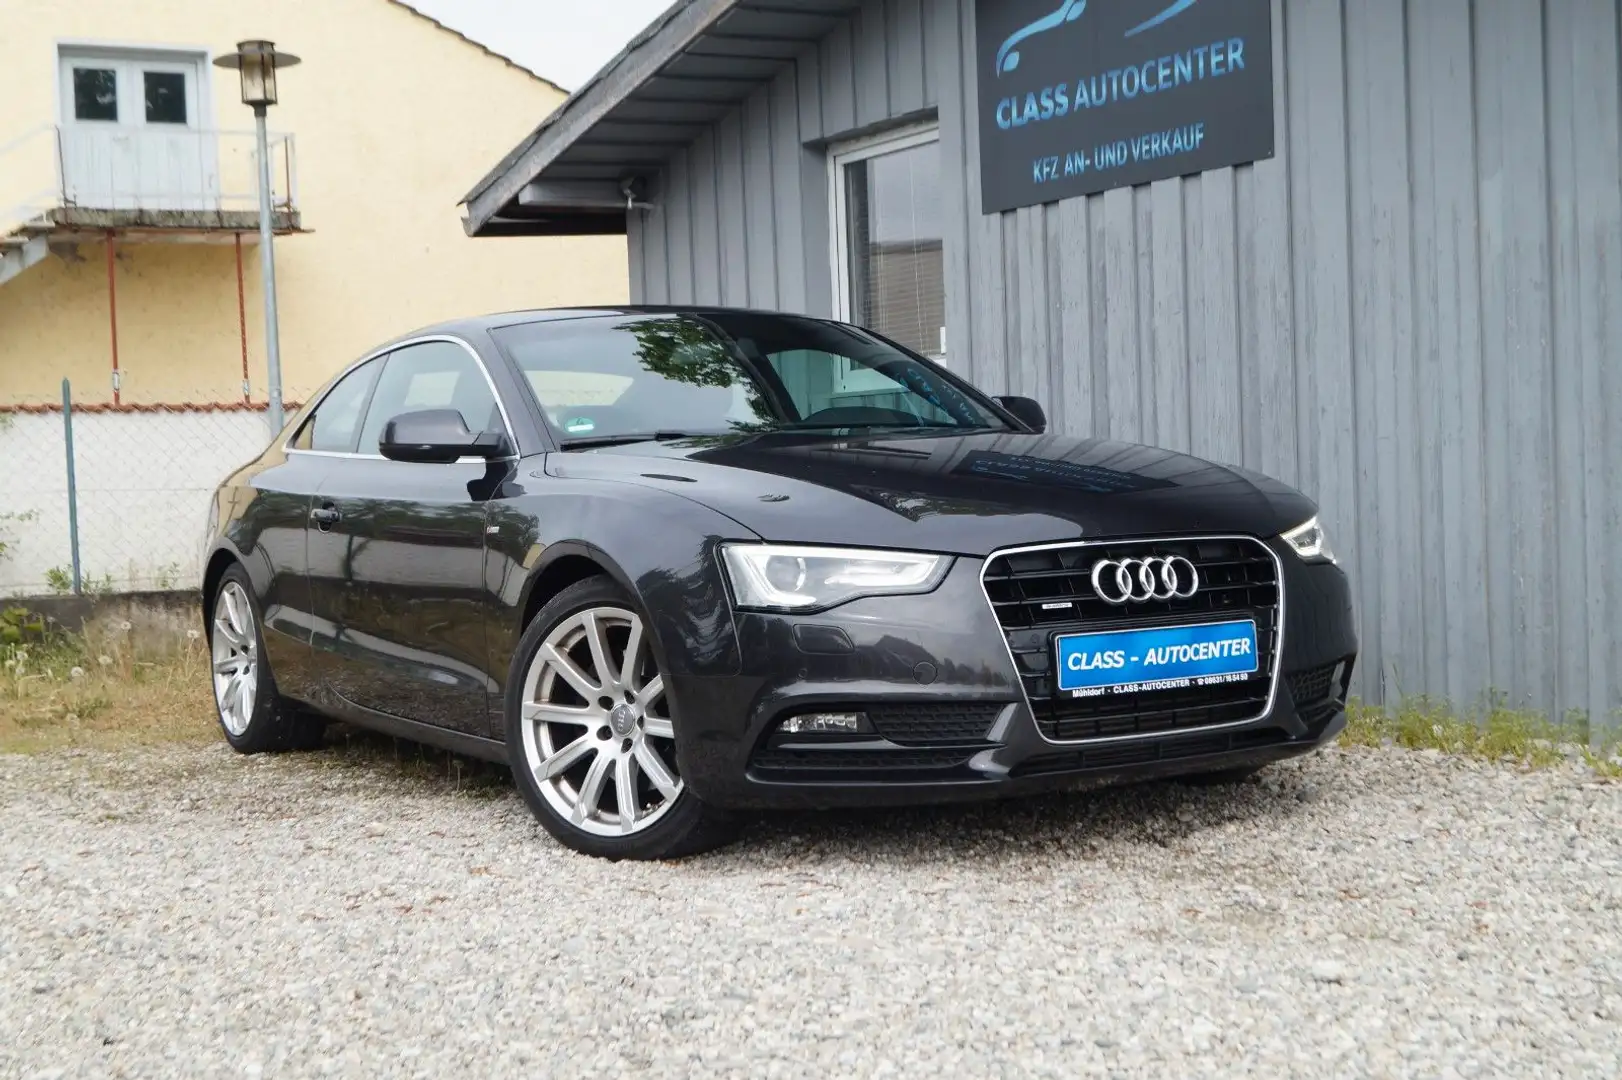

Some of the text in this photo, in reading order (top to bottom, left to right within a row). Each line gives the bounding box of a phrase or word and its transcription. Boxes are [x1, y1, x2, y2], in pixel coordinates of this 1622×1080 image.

[996, 37, 1245, 129] CLASS AUTOCENTER
[1033, 122, 1204, 183] KFZ AN- UND VERKAUF
[1067, 650, 1126, 671] CLASS
[1143, 637, 1251, 666] AUTOCENTER
